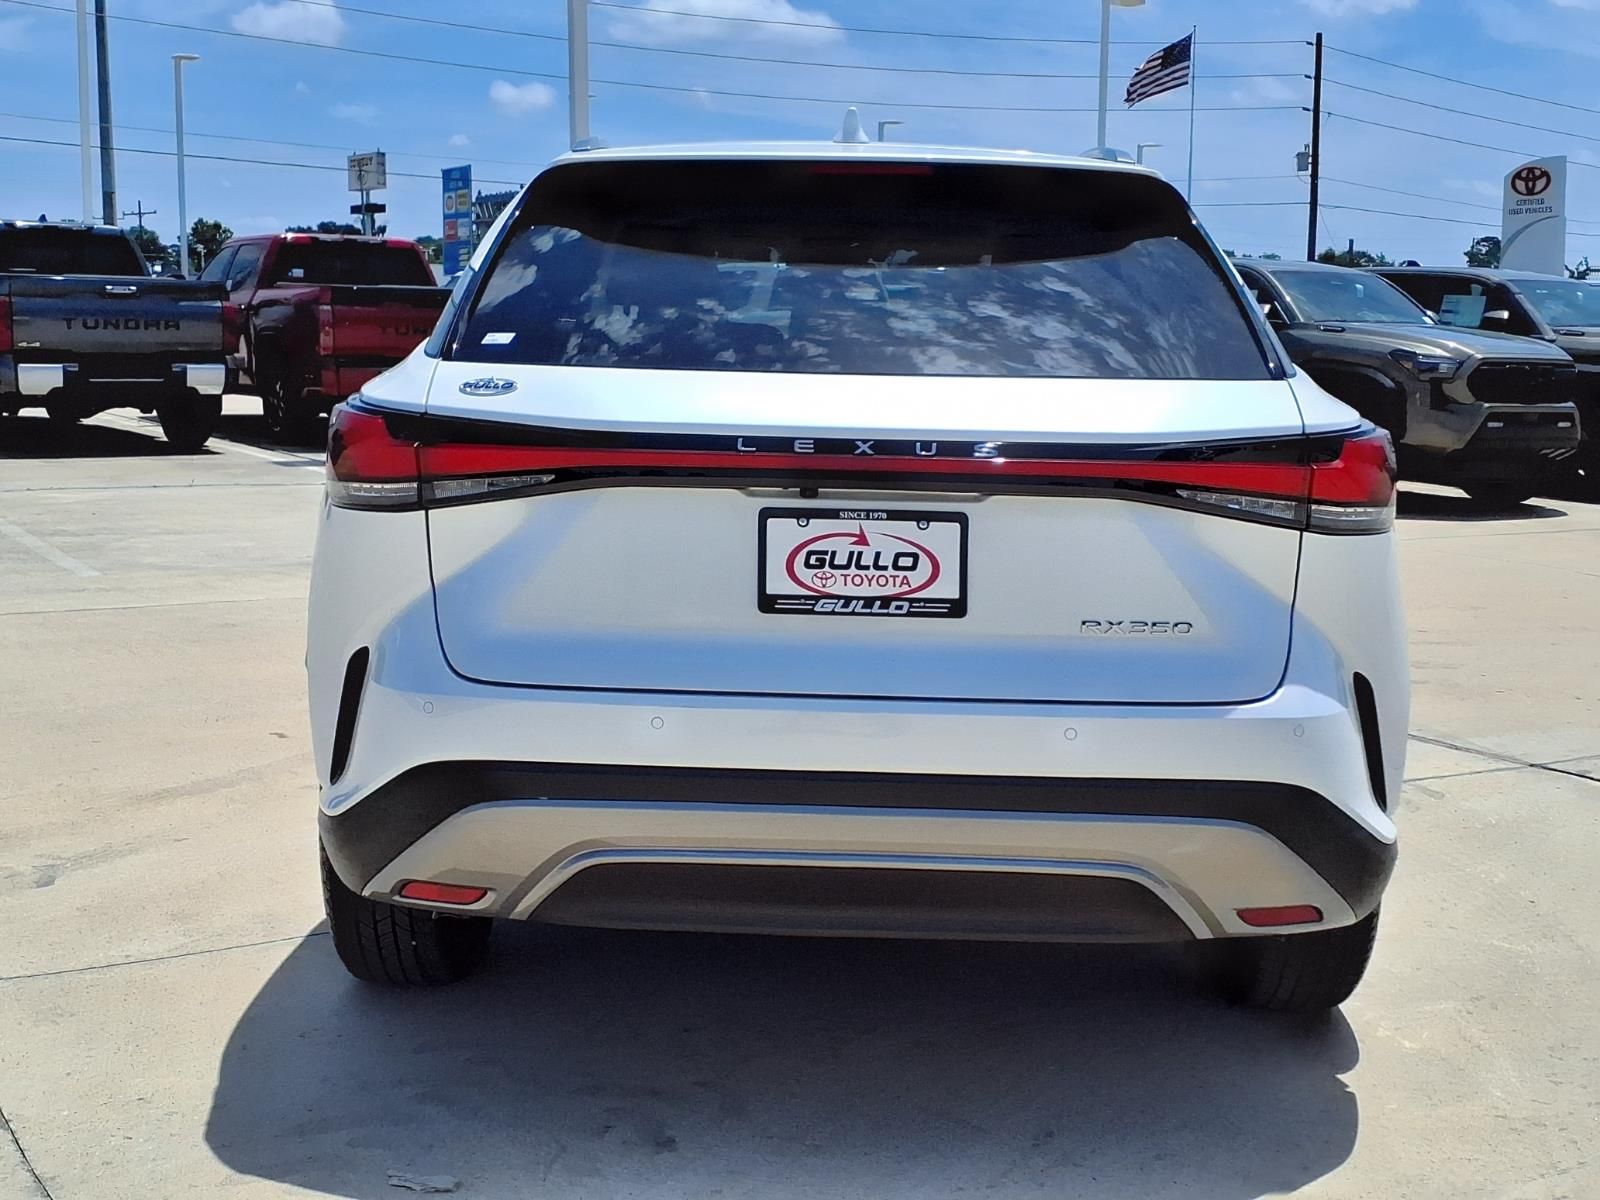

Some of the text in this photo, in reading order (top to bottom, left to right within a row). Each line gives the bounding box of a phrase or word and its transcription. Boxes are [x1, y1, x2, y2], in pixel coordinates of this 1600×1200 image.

[1515, 198, 1545, 207] CERTIFIED
[1508, 206, 1553, 216] USED VEHICLES
[63, 317, 181, 331] TUNDRA
[463, 381, 514, 389] GULLO
[737, 437, 1001, 457] LEXUS
[839, 511, 888, 520] SINCE 1970
[803, 549, 920, 571] GULLO
[840, 573, 912, 588] TOYOTA
[813, 599, 910, 614] GULLO
